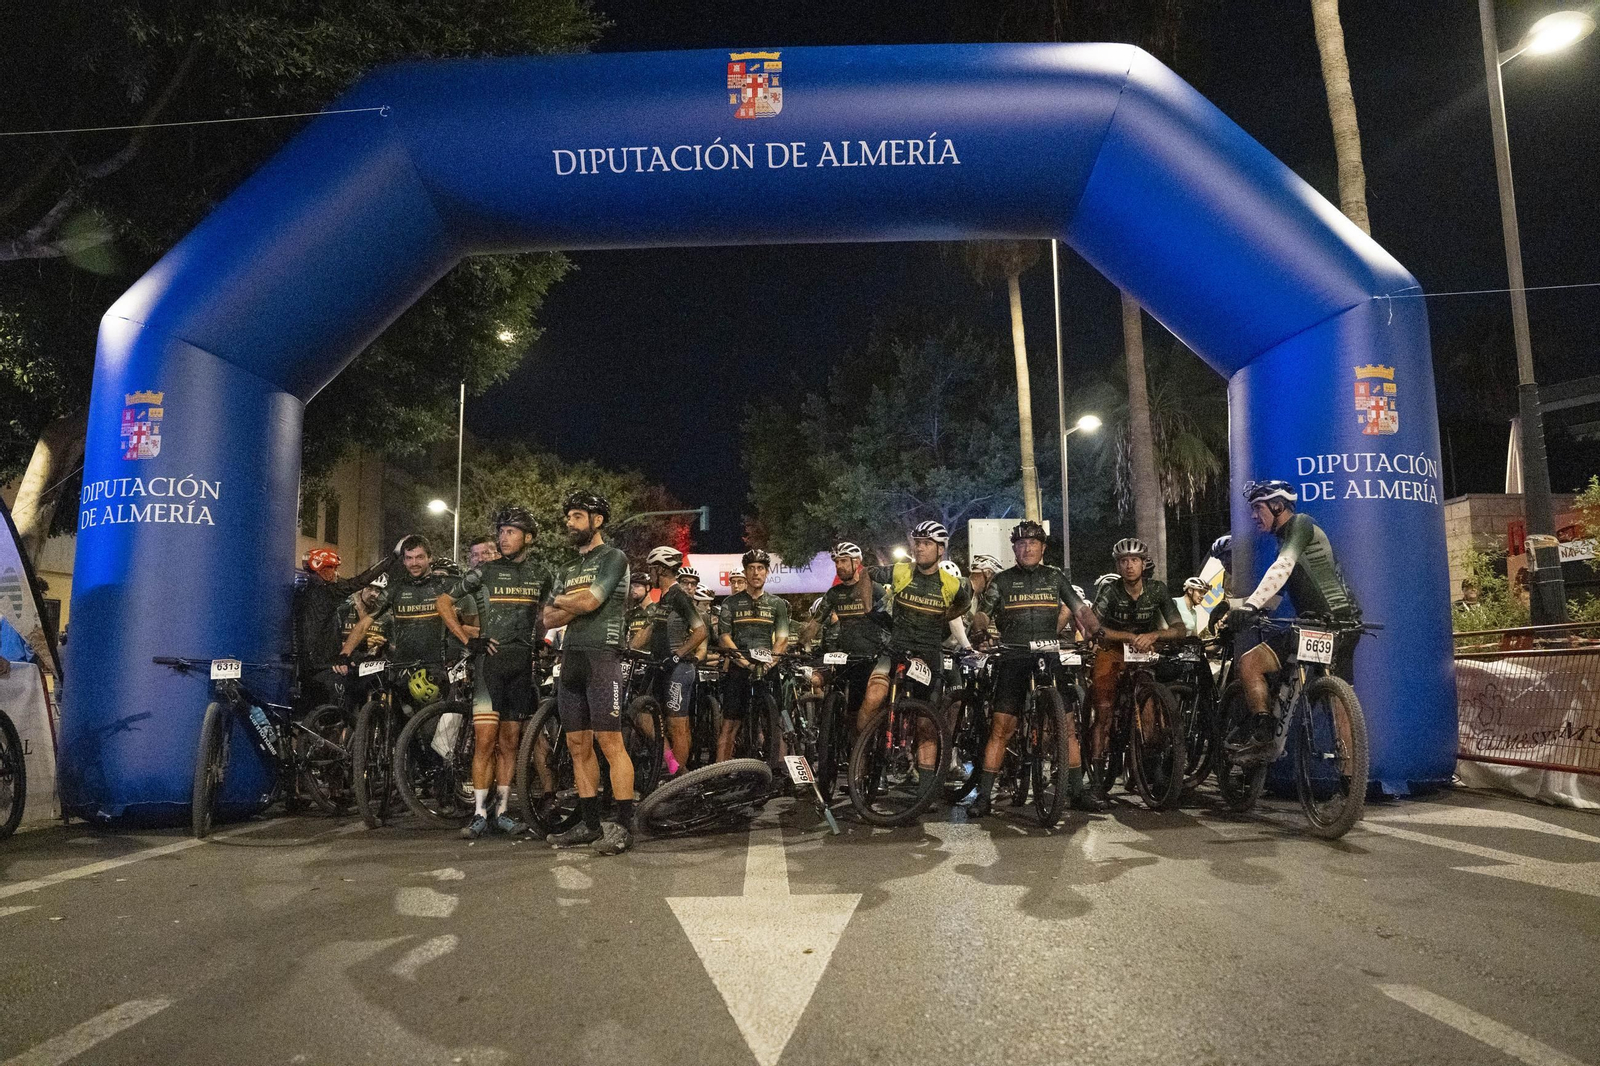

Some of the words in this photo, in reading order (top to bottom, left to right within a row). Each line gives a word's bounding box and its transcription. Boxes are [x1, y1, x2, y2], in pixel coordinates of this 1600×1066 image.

[552, 137, 755, 176] DIPUTACIÓN
[765, 142, 808, 169] DE
[816, 132, 961, 168] ALMERÍA
[1296, 452, 1438, 479] DIPUTACIÓN
[82, 473, 221, 504] DIPUTACIÓN
[1300, 481, 1336, 502] DE
[1343, 479, 1439, 505] ALMERÍA
[81, 508, 97, 529] DE
[101, 500, 216, 525] ALMERÍA
[494, 586, 504, 595] LA
[899, 591, 908, 600] LA
[1009, 594, 1017, 602] LA
[398, 605, 406, 613] LA
[1305, 638, 1332, 654] 6639
[216, 662, 240, 671] 6313
[612, 681, 620, 710] gacosur
[793, 760, 809, 782] 7059
